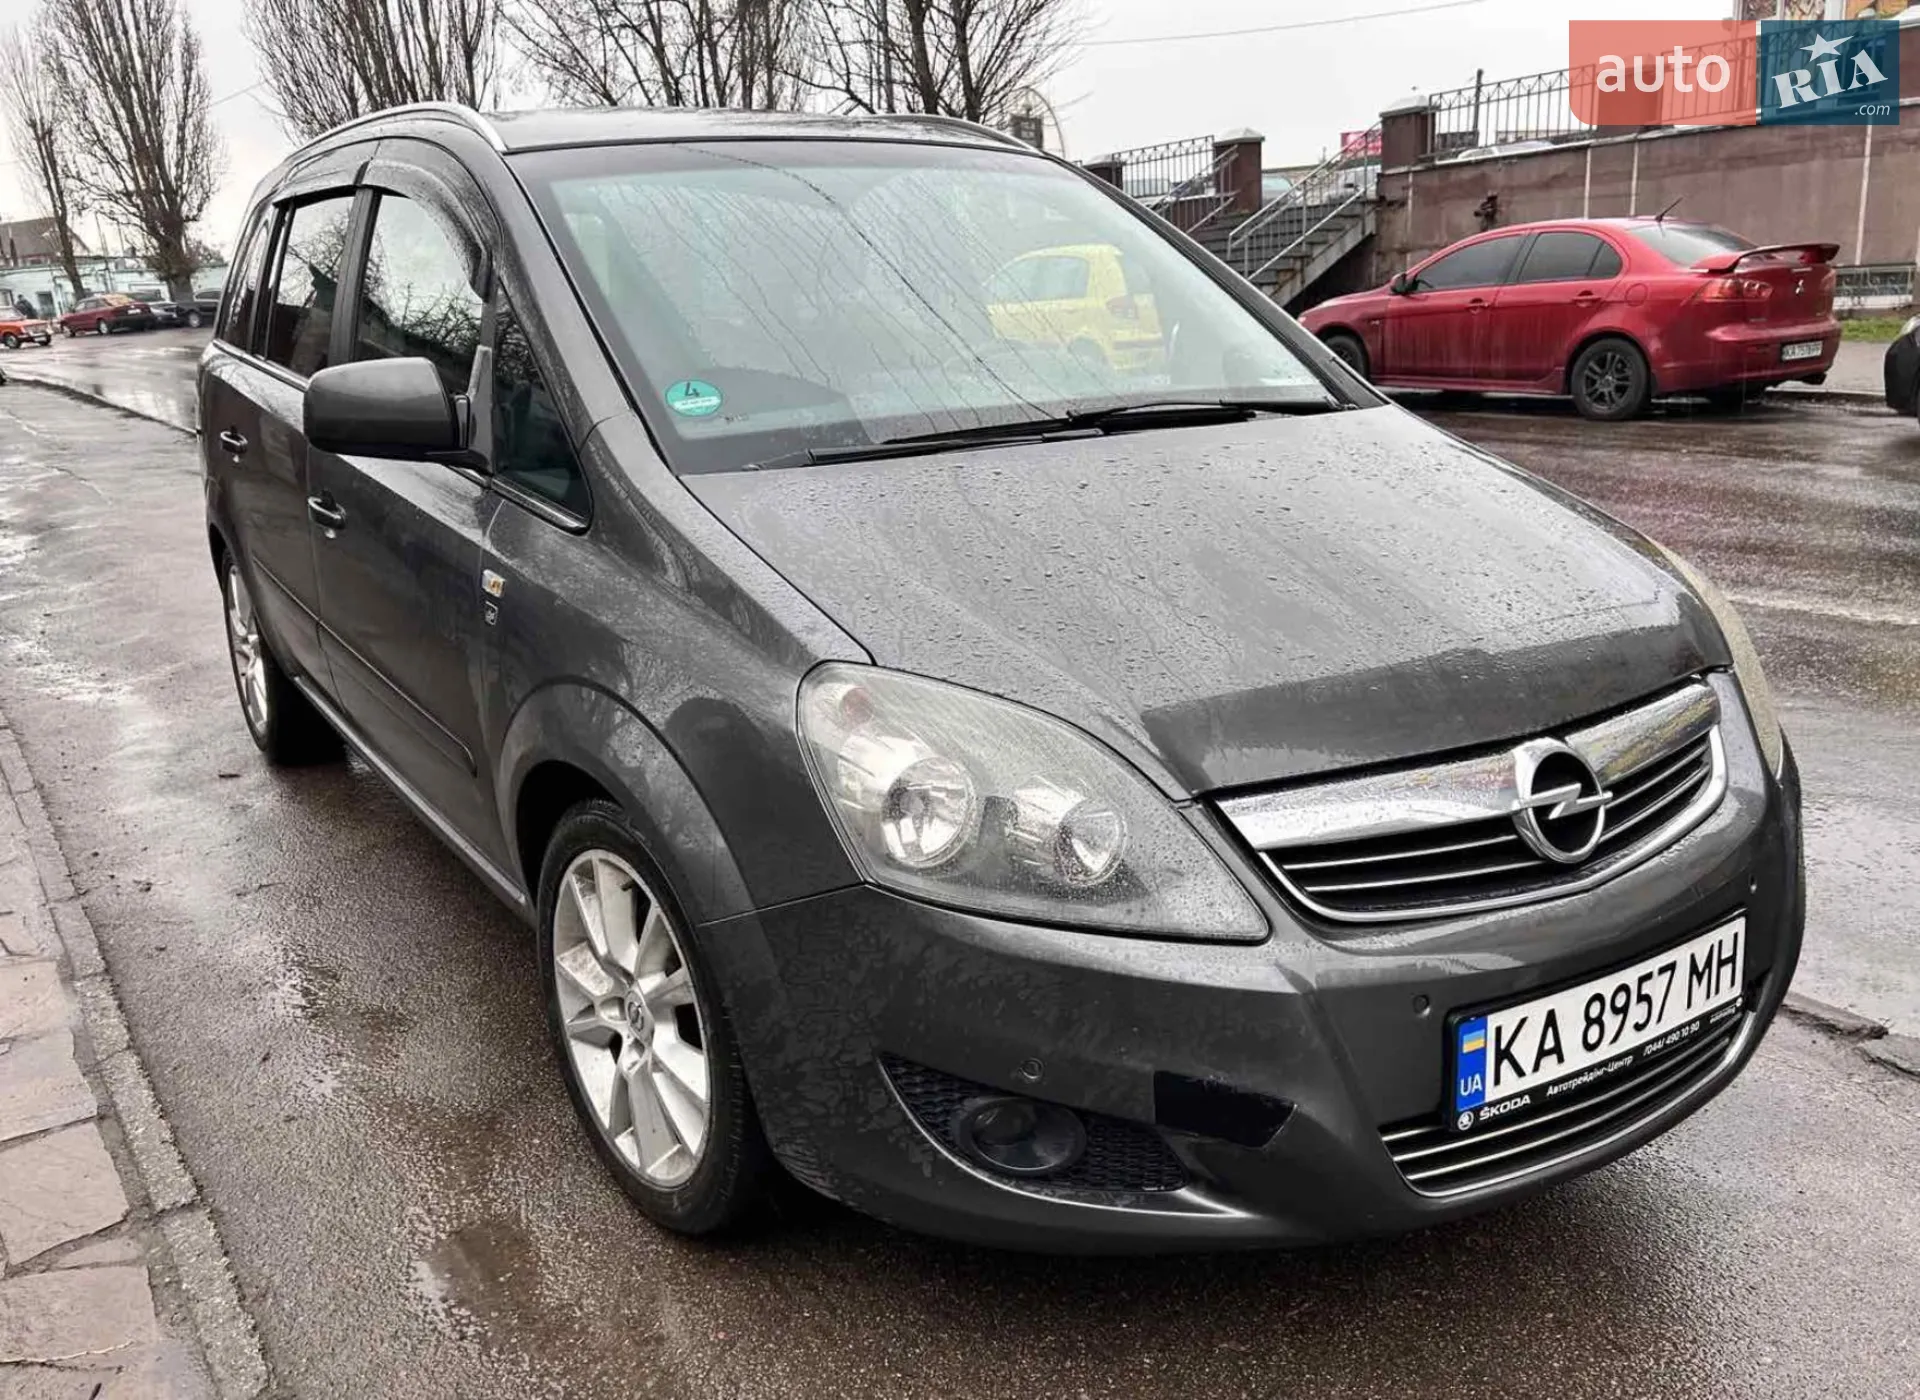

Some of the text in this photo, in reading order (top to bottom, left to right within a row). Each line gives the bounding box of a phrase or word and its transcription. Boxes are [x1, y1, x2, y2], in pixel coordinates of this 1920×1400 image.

[1493, 931, 1739, 1087] KA 8957 MH
[1460, 1073, 1482, 1096] UA
[1479, 1094, 1531, 1121] ŠKODA
